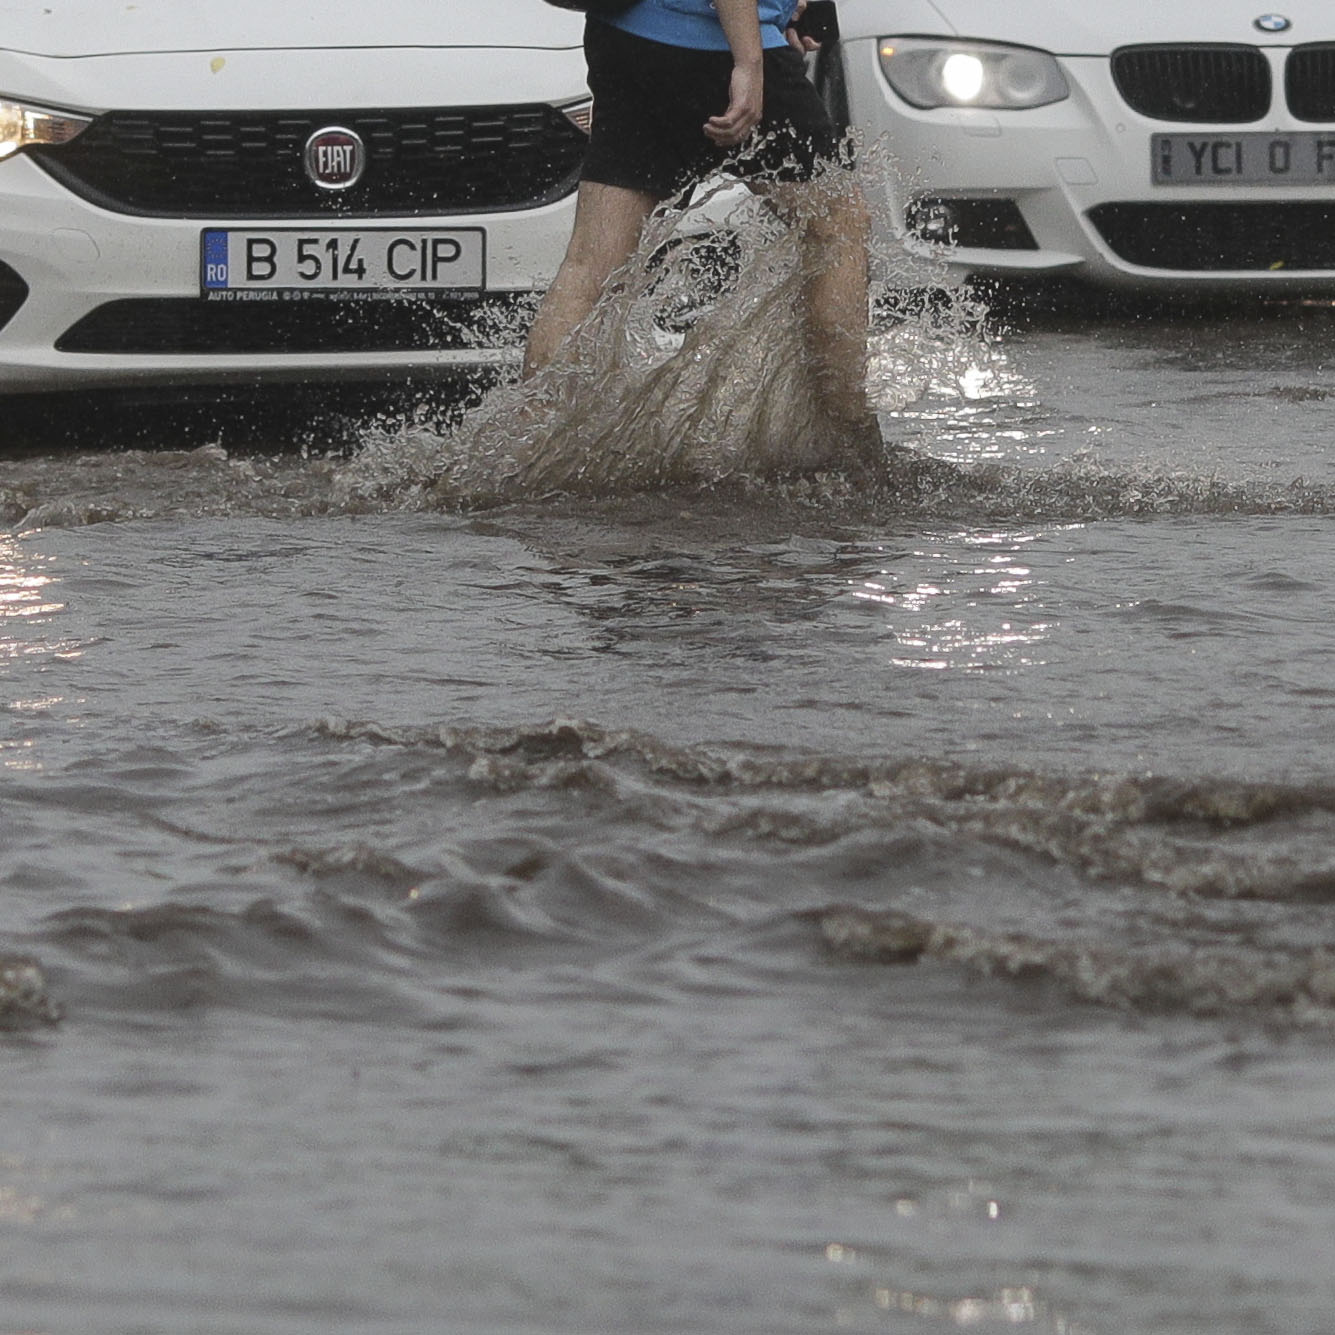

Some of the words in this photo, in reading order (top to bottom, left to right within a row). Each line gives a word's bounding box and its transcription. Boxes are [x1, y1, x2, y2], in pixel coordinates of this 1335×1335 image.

[318, 145, 353, 173] FIAT
[246, 238, 277, 281] B
[297, 238, 366, 281] 514
[387, 238, 462, 281] CIP
[207, 263, 227, 282] RO
[208, 290, 234, 301] AUTO
[236, 290, 279, 301] PERUGIA
